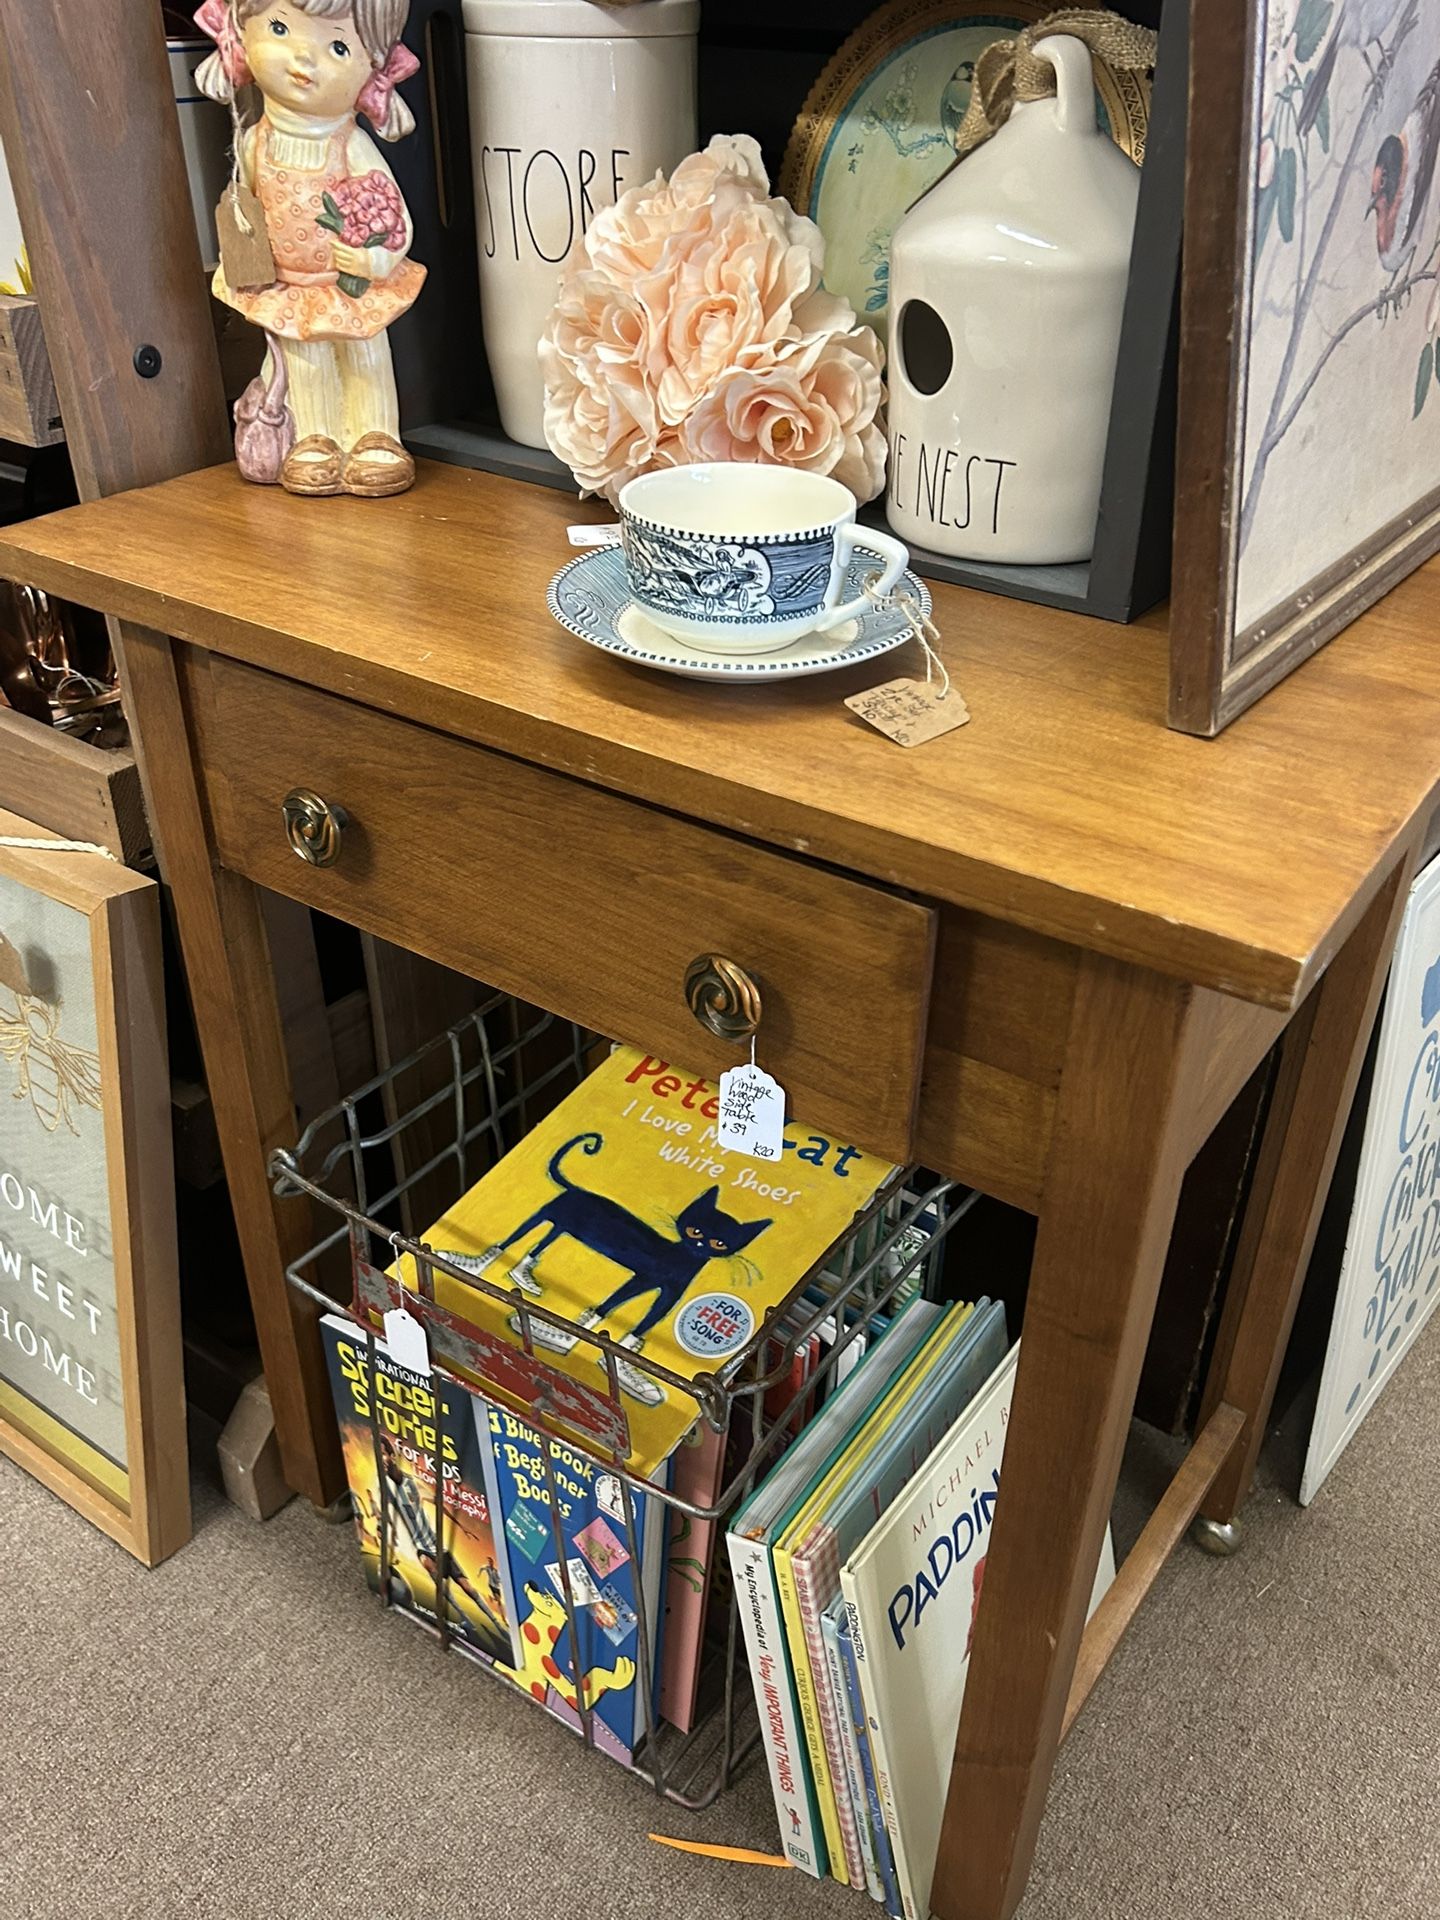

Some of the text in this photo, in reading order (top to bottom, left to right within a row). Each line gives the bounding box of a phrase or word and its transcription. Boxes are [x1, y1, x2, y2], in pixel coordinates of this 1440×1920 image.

[916, 443, 1017, 534] NEST
[622, 1099, 734, 1155] I Love M
[625, 1055, 863, 1177] Pete at
[659, 1140, 802, 1207] White Shoes
[0, 1172, 87, 1257] OME
[0, 1240, 101, 1336] WEET
[715, 1300, 742, 1321] FOR
[690, 1319, 725, 1344] SONG
[697, 1306, 740, 1338] FREE
[502, 1413, 541, 1448] Blue
[424, 1453, 462, 1483] KDS
[503, 1444, 588, 1499] Beginer
[512, 1472, 572, 1517] Boos
[912, 1429, 993, 1543] MICHAEL
[442, 1491, 488, 1520] iography
[451, 1484, 487, 1508] Messi
[745, 1564, 796, 1795] My Encyclopedia of Very IMPORTANT THINGS
